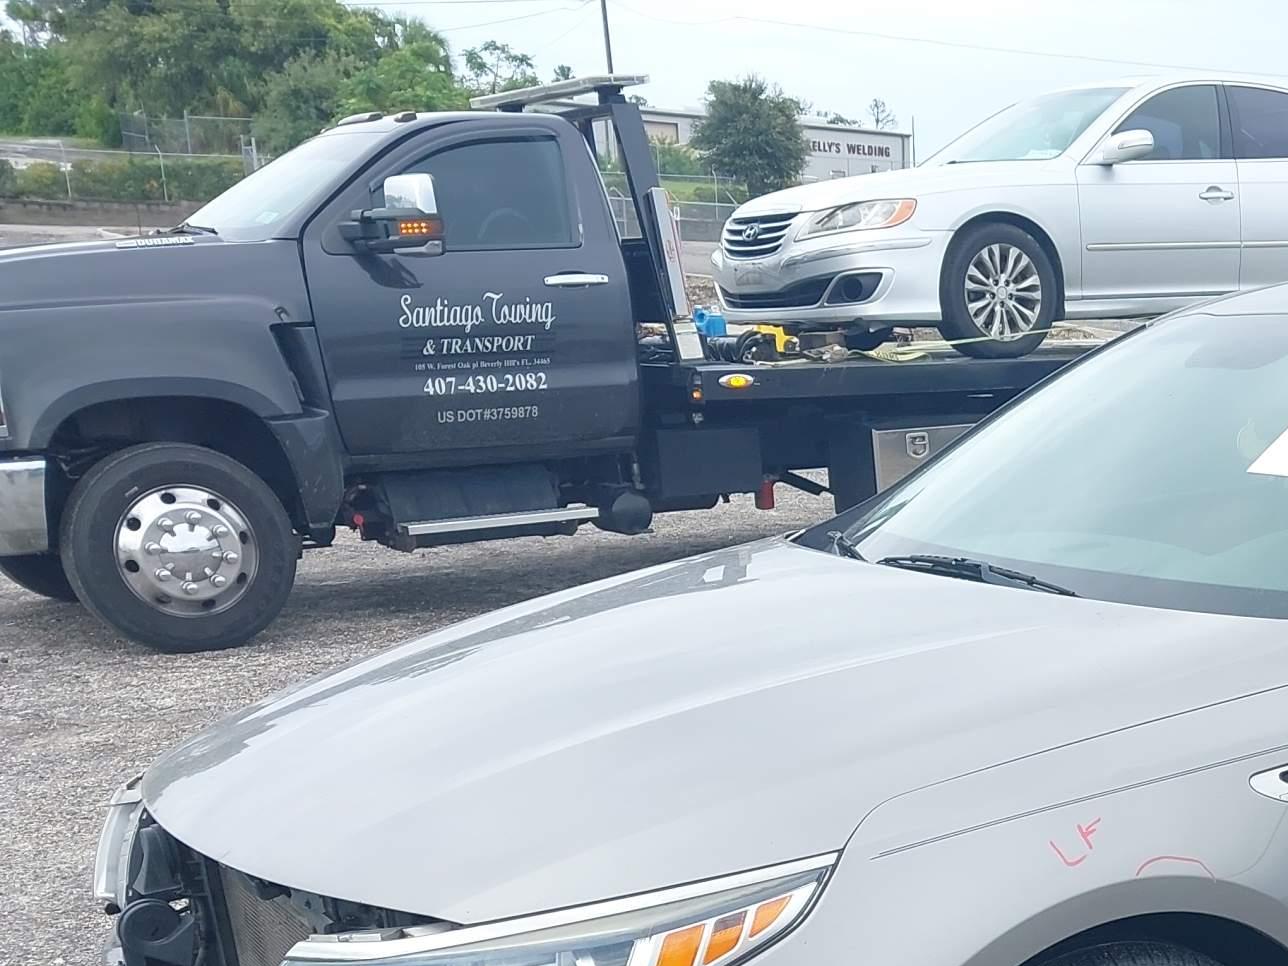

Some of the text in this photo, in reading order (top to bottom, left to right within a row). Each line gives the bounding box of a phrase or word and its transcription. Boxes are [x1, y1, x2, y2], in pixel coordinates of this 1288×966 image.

[847, 143, 891, 158] WELDING
[399, 292, 556, 333] Santiago Towing
[423, 335, 536, 355] & TRANSPORT
[457, 361, 471, 369] Oak
[480, 359, 502, 369] Beverly
[423, 372, 549, 395] 407-430-2082
[437, 405, 539, 423] US DOT#3759878
[1049, 817, 1101, 867] LF
